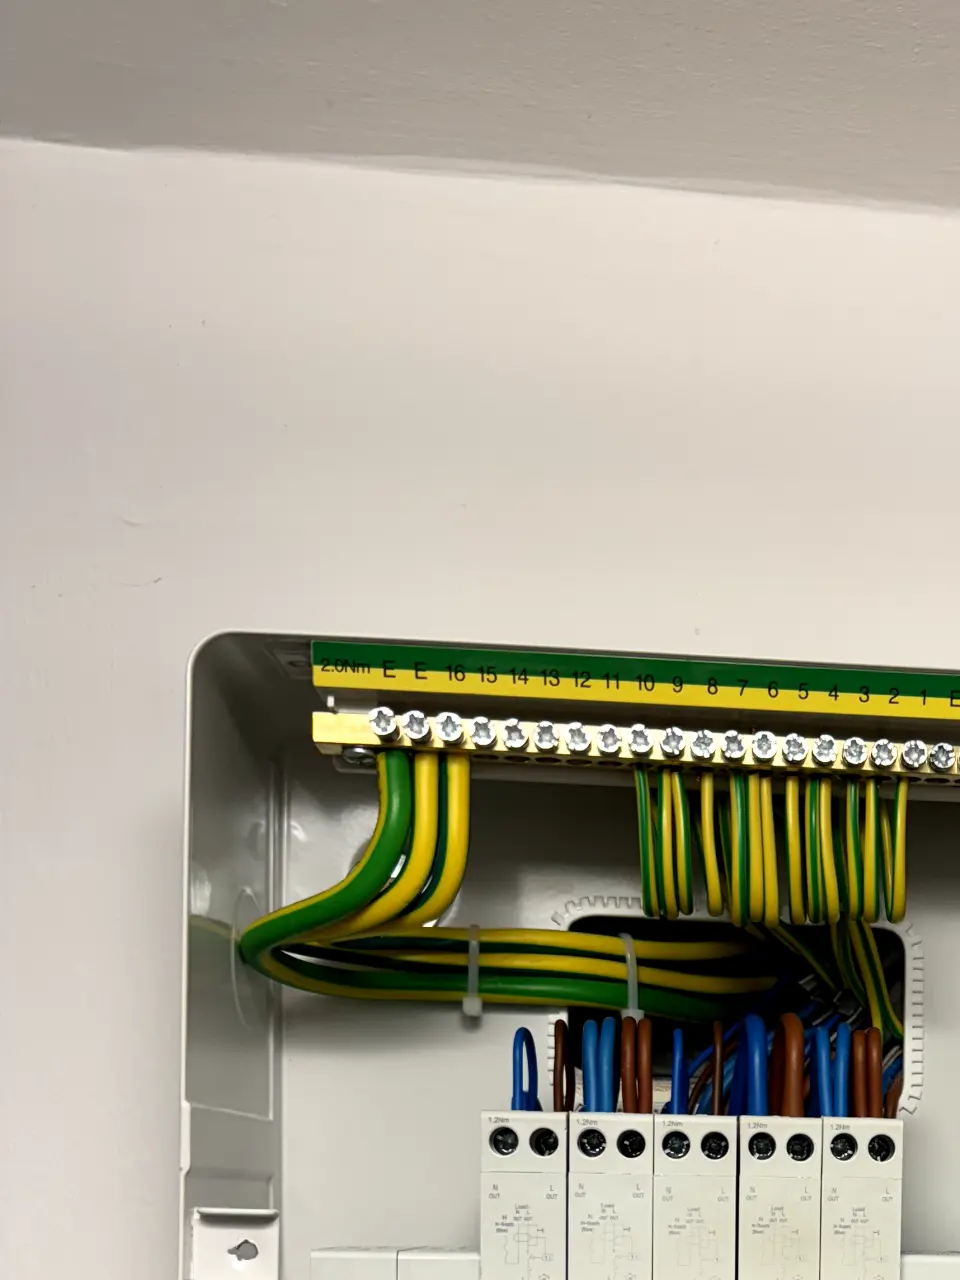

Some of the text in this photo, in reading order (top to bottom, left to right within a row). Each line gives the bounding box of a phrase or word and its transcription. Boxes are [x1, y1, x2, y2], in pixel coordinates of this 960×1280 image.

[320, 658, 371, 675] 2.0Nm
[383, 660, 396, 679] E
[415, 661, 427, 680] E
[447, 664, 465, 682] 16
[478, 665, 498, 684] 15
[510, 667, 529, 685] 14
[541, 668, 560, 687] 13
[572, 670, 592, 688] 12
[603, 672, 620, 690] 11
[635, 673, 655, 692] 10
[672, 675, 683, 693] 9
[708, 678, 718, 696] 8
[737, 679, 748, 696] 7
[768, 681, 779, 699] 6
[799, 682, 809, 700] 5
[828, 684, 840, 701] 4
[859, 685, 870, 703] 3
[889, 687, 900, 705] 2
[920, 689, 927, 706] 1
